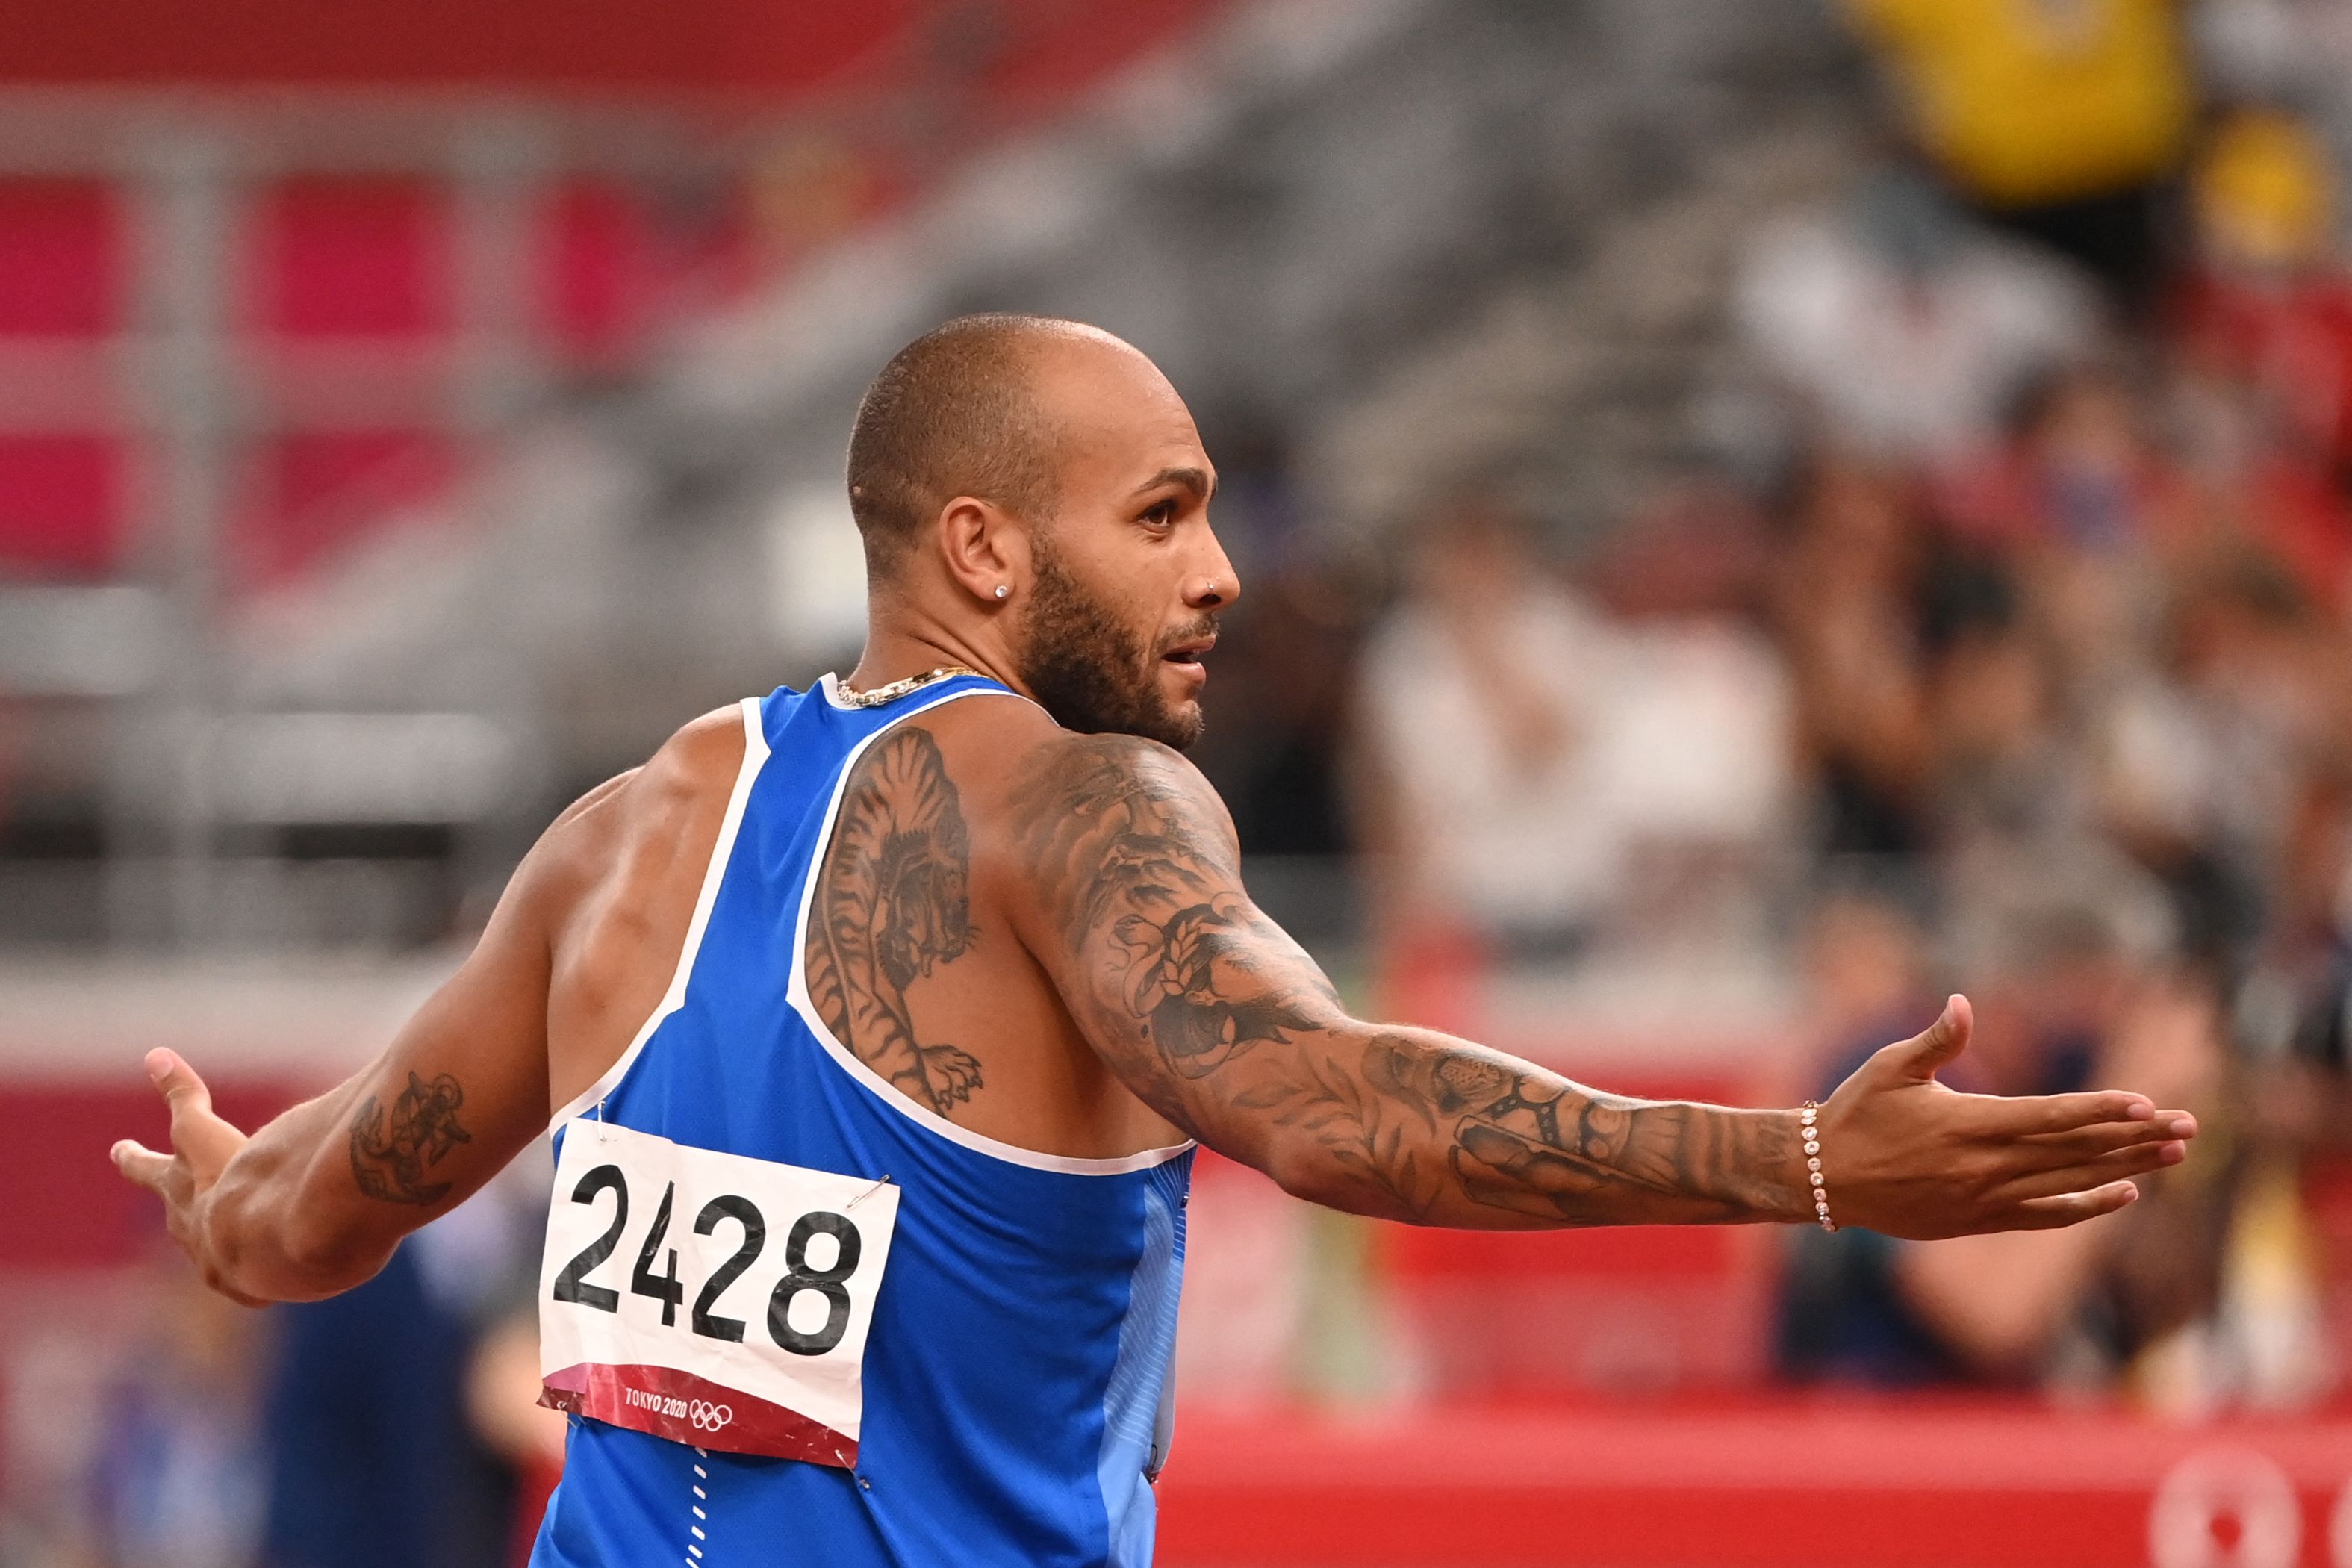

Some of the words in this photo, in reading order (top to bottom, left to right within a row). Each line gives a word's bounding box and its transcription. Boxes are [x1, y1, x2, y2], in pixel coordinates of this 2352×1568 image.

[553, 1164, 862, 1356] 2428
[625, 1387, 662, 1412] TOKYO
[662, 1397, 688, 1419] 2020
